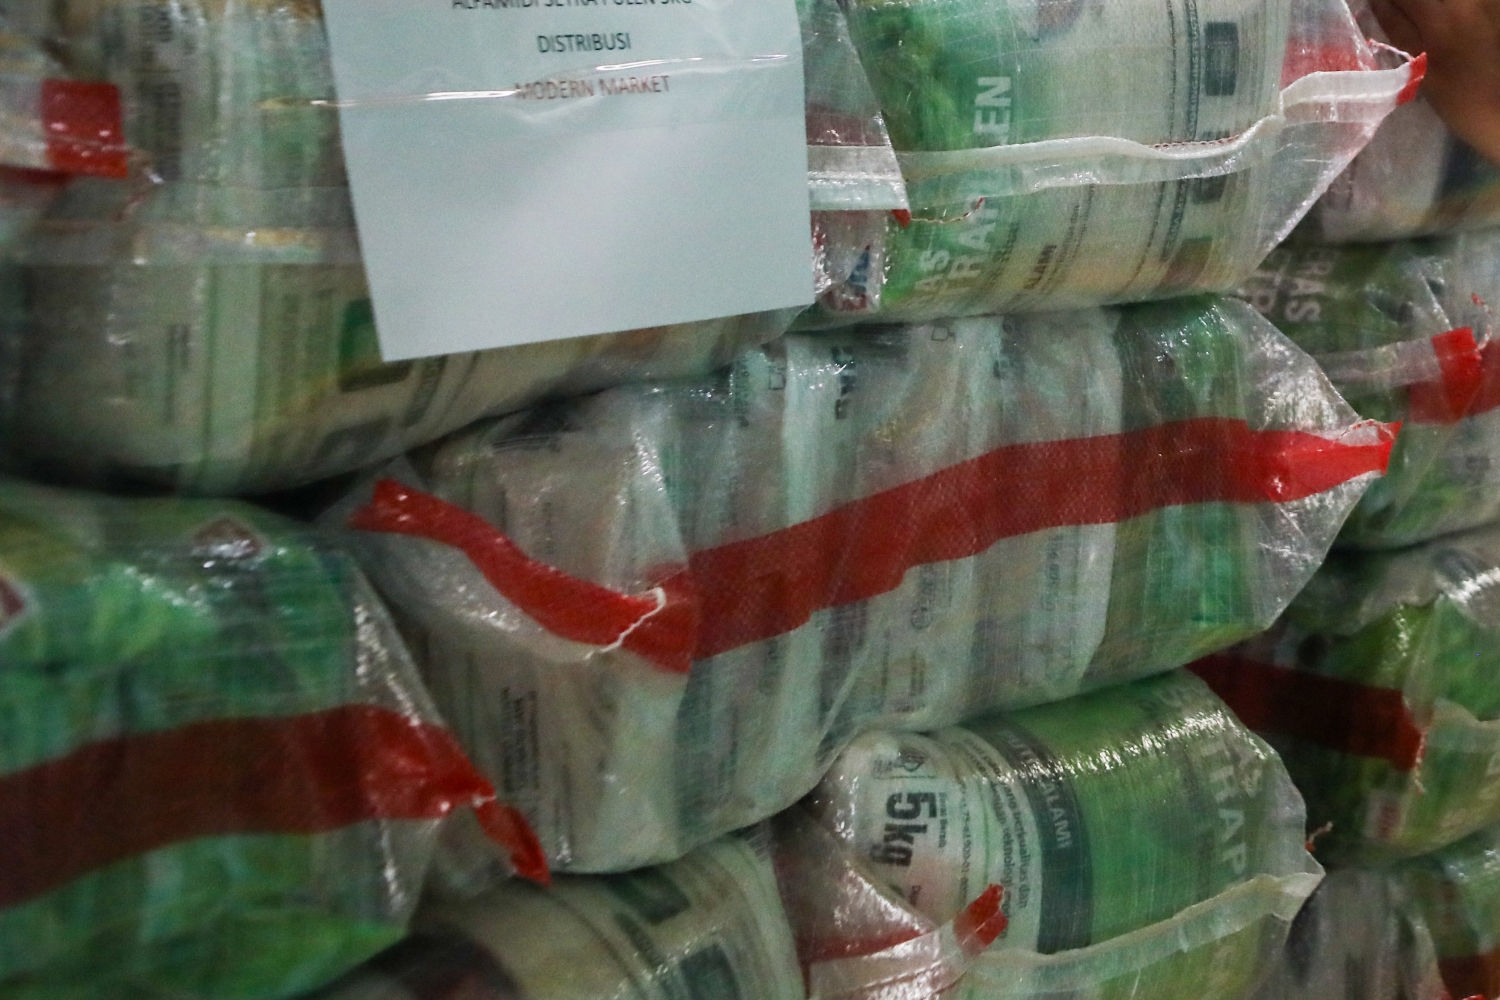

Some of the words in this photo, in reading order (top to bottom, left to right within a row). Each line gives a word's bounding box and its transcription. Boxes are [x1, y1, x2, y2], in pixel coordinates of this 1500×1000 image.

[537, 32, 632, 53] DISTRIBUSI
[514, 79, 595, 101] MODERN
[599, 75, 670, 96] MARKET
[870, 792, 938, 867] 5kg
